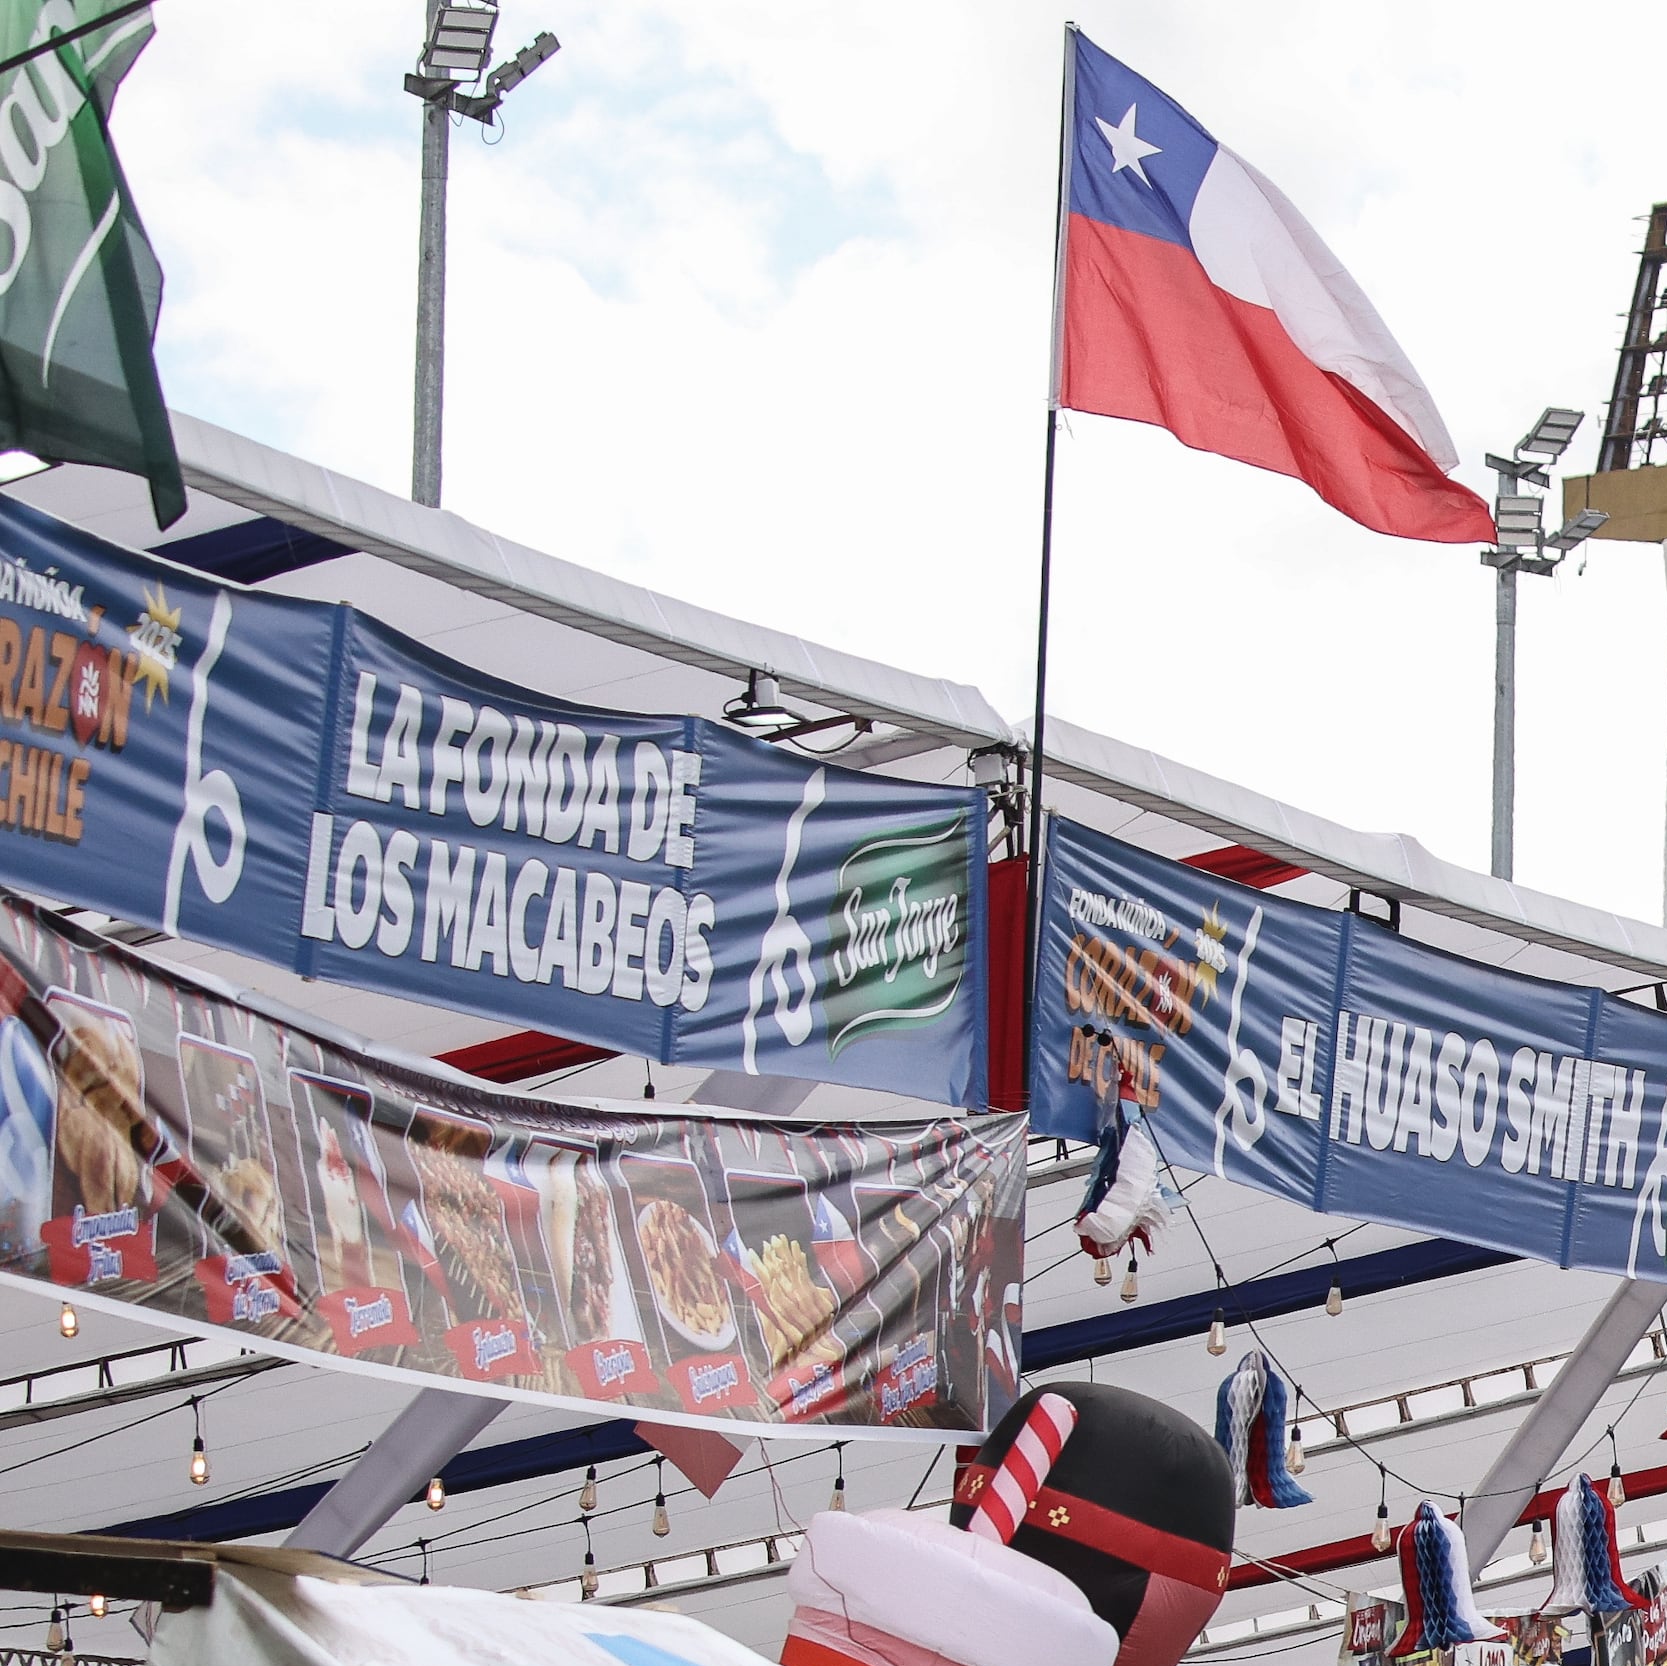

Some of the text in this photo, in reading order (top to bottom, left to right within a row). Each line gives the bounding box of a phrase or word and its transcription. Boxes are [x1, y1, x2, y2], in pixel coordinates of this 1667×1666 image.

[345, 670, 701, 869] LA FONDA DE
[301, 810, 716, 1012] LOS MACABEOS
[832, 876, 961, 986] San Jorge
[1070, 887, 1119, 930] FONDA
[1273, 1010, 1647, 1191] EL HUASO SMITH
